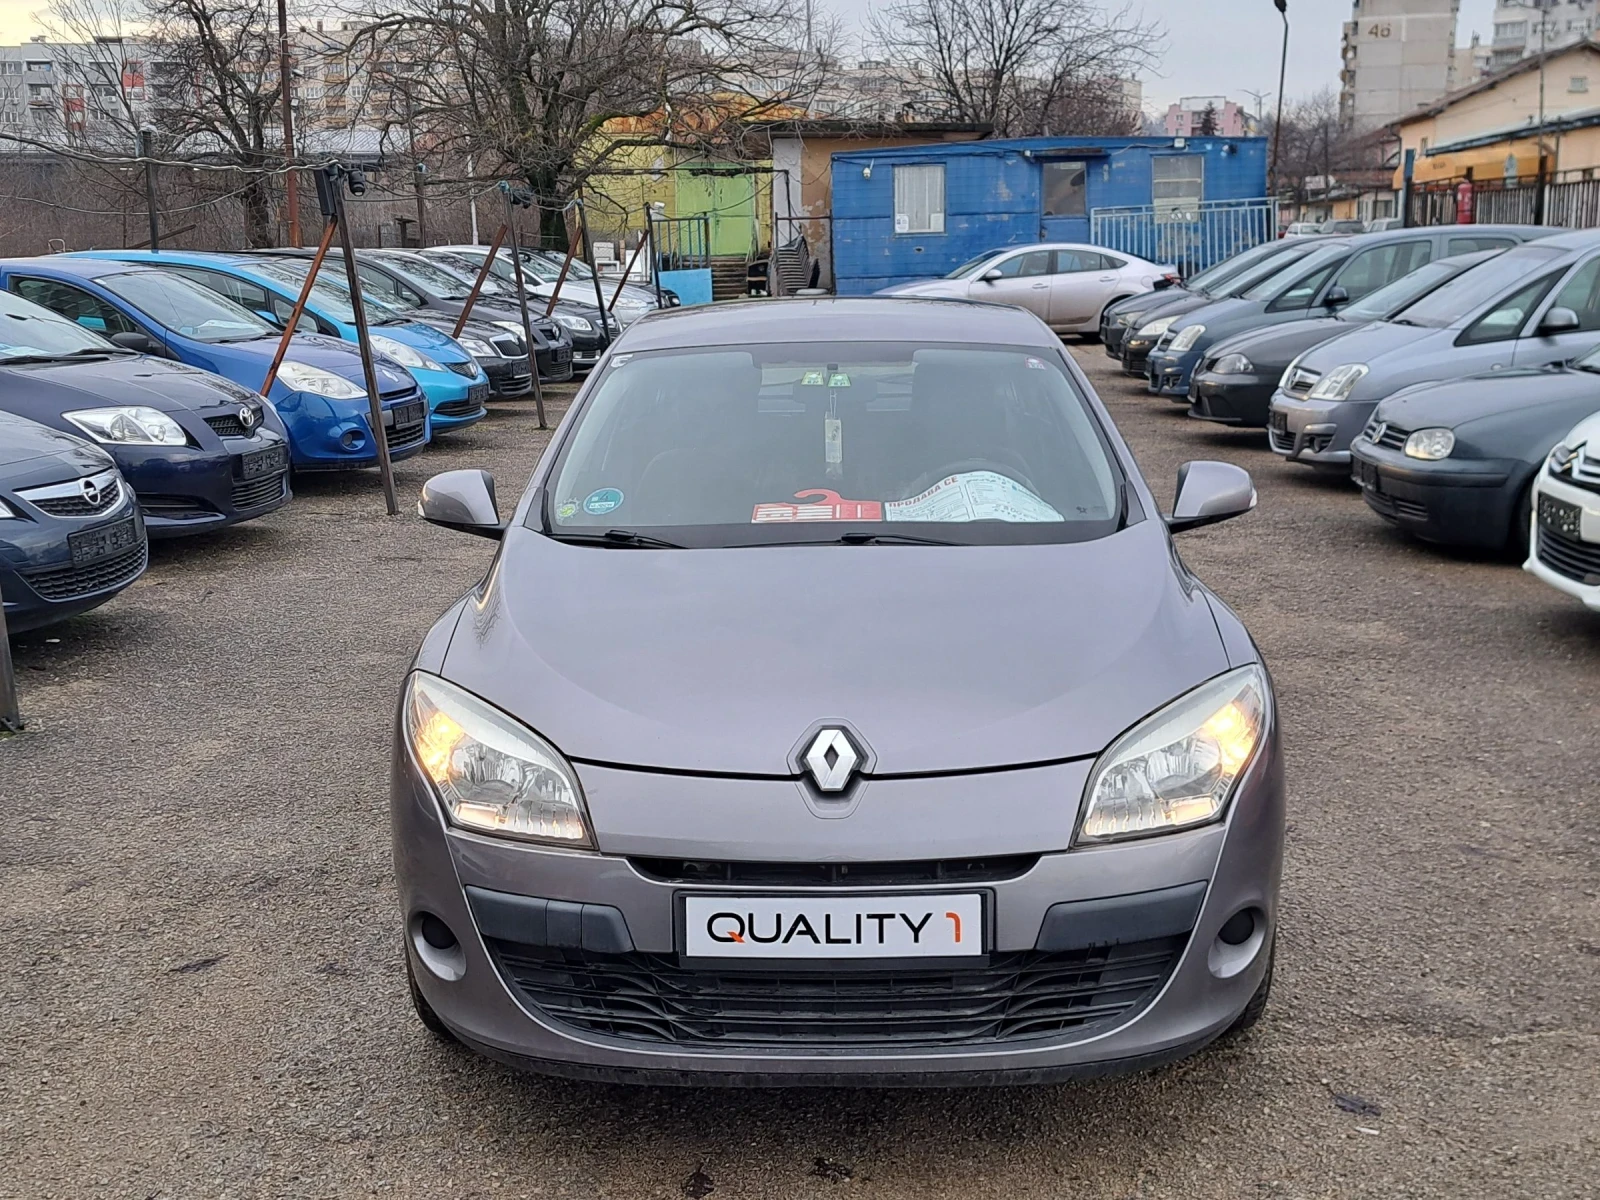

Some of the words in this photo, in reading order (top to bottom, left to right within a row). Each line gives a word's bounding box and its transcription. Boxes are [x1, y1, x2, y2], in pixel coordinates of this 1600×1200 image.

[888, 484, 942, 508] ПРОДАВА
[943, 475, 959, 487] СЕ
[706, 912, 934, 944] QUALITY
[945, 912, 961, 943] 1
